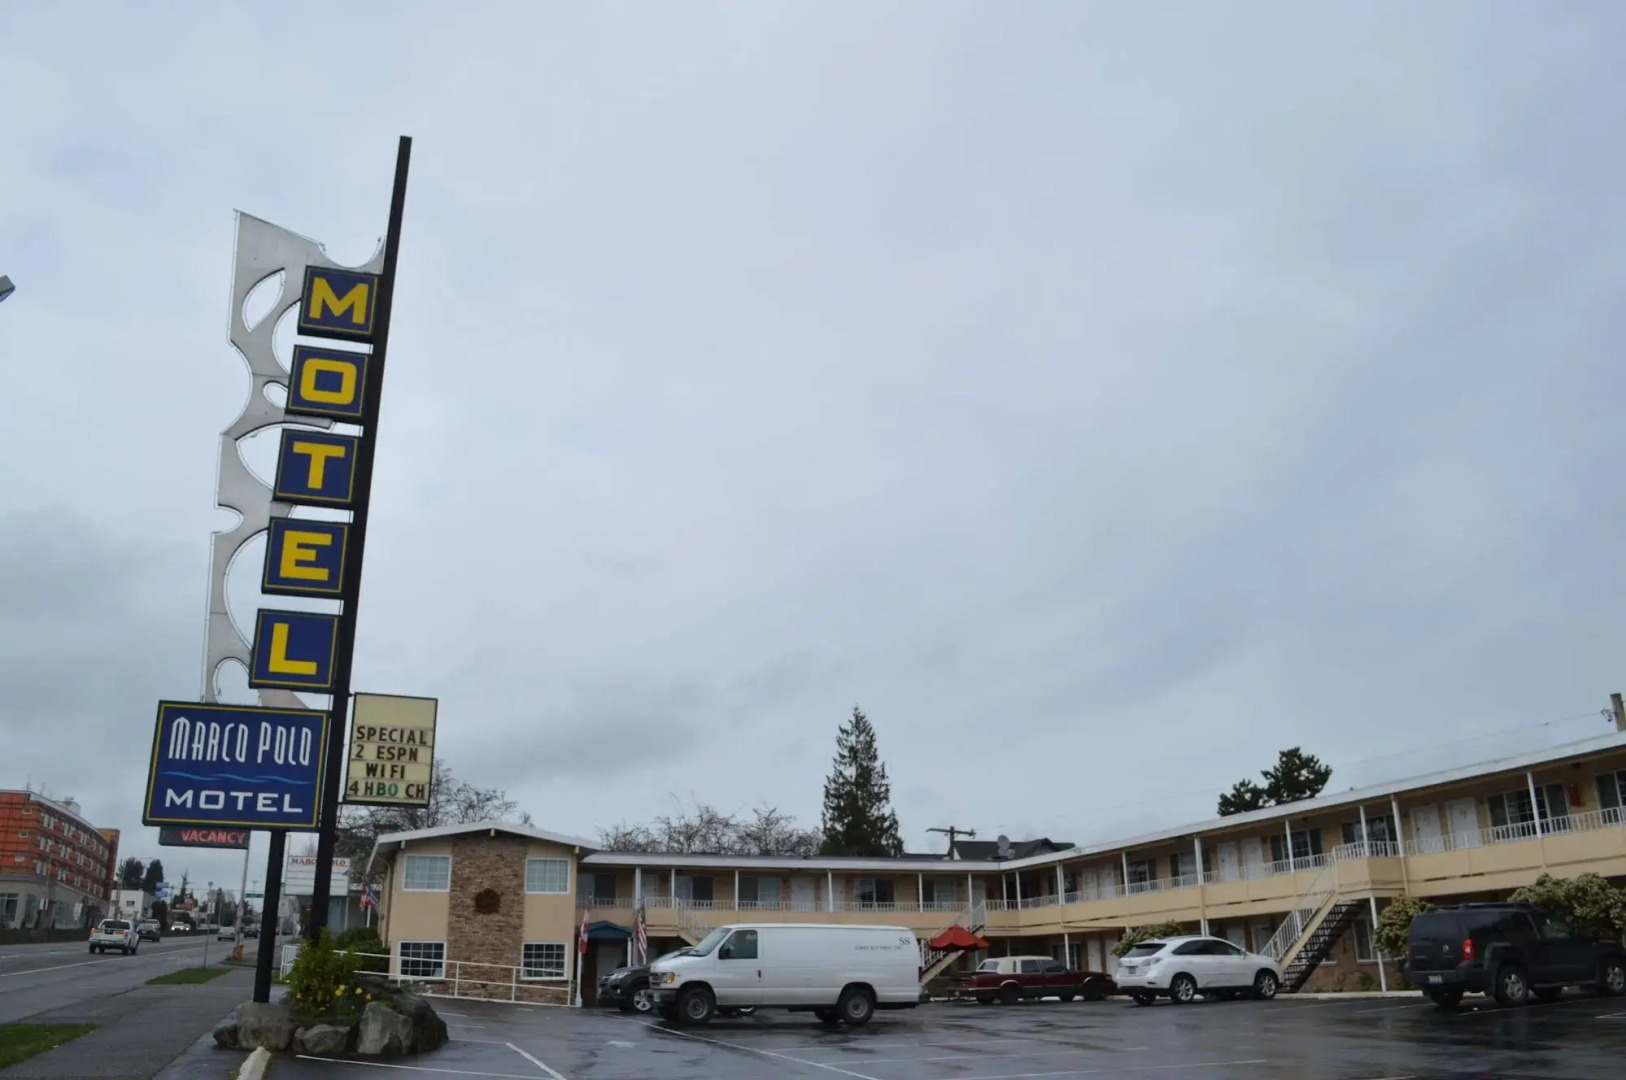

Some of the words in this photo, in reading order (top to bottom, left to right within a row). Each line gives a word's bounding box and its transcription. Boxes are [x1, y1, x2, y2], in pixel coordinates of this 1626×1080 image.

[268, 276, 369, 676] MOTEL
[168, 716, 249, 764] MARCO
[257, 721, 313, 767] POLO
[356, 725, 428, 745] SPECIAL
[355, 744, 365, 759] 2
[376, 745, 419, 762] ESPN
[348, 780, 360, 794] 4
[364, 781, 399, 797] HBO
[405, 783, 426, 799] CH
[165, 788, 303, 813] MOTEL
[181, 829, 246, 845] VACANCY
[291, 858, 316, 866] MARC
